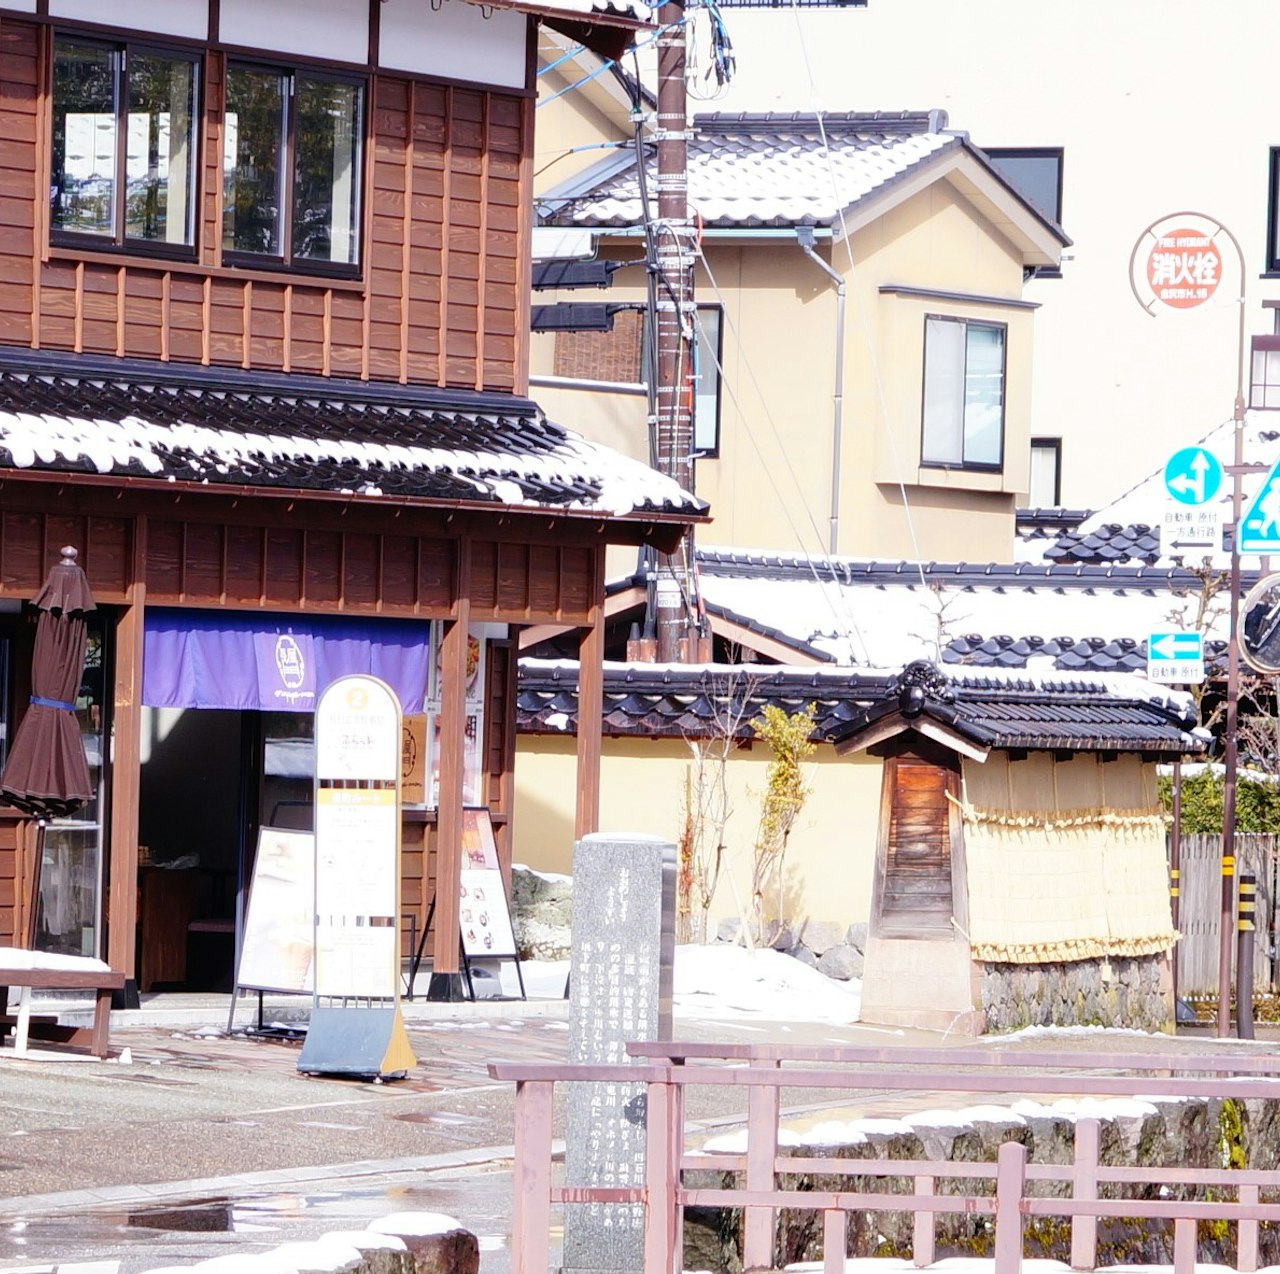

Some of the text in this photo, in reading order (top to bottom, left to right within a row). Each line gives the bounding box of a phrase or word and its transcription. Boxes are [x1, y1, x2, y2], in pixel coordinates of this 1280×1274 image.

[1159, 237, 1210, 248] FIRE HYDRANT
[1152, 251, 1218, 285] 消火栓
[1165, 512, 1218, 523] 自動車 原付
[1166, 527, 1216, 538] 一方通行路
[1152, 667, 1198, 678] 自動車 原付
